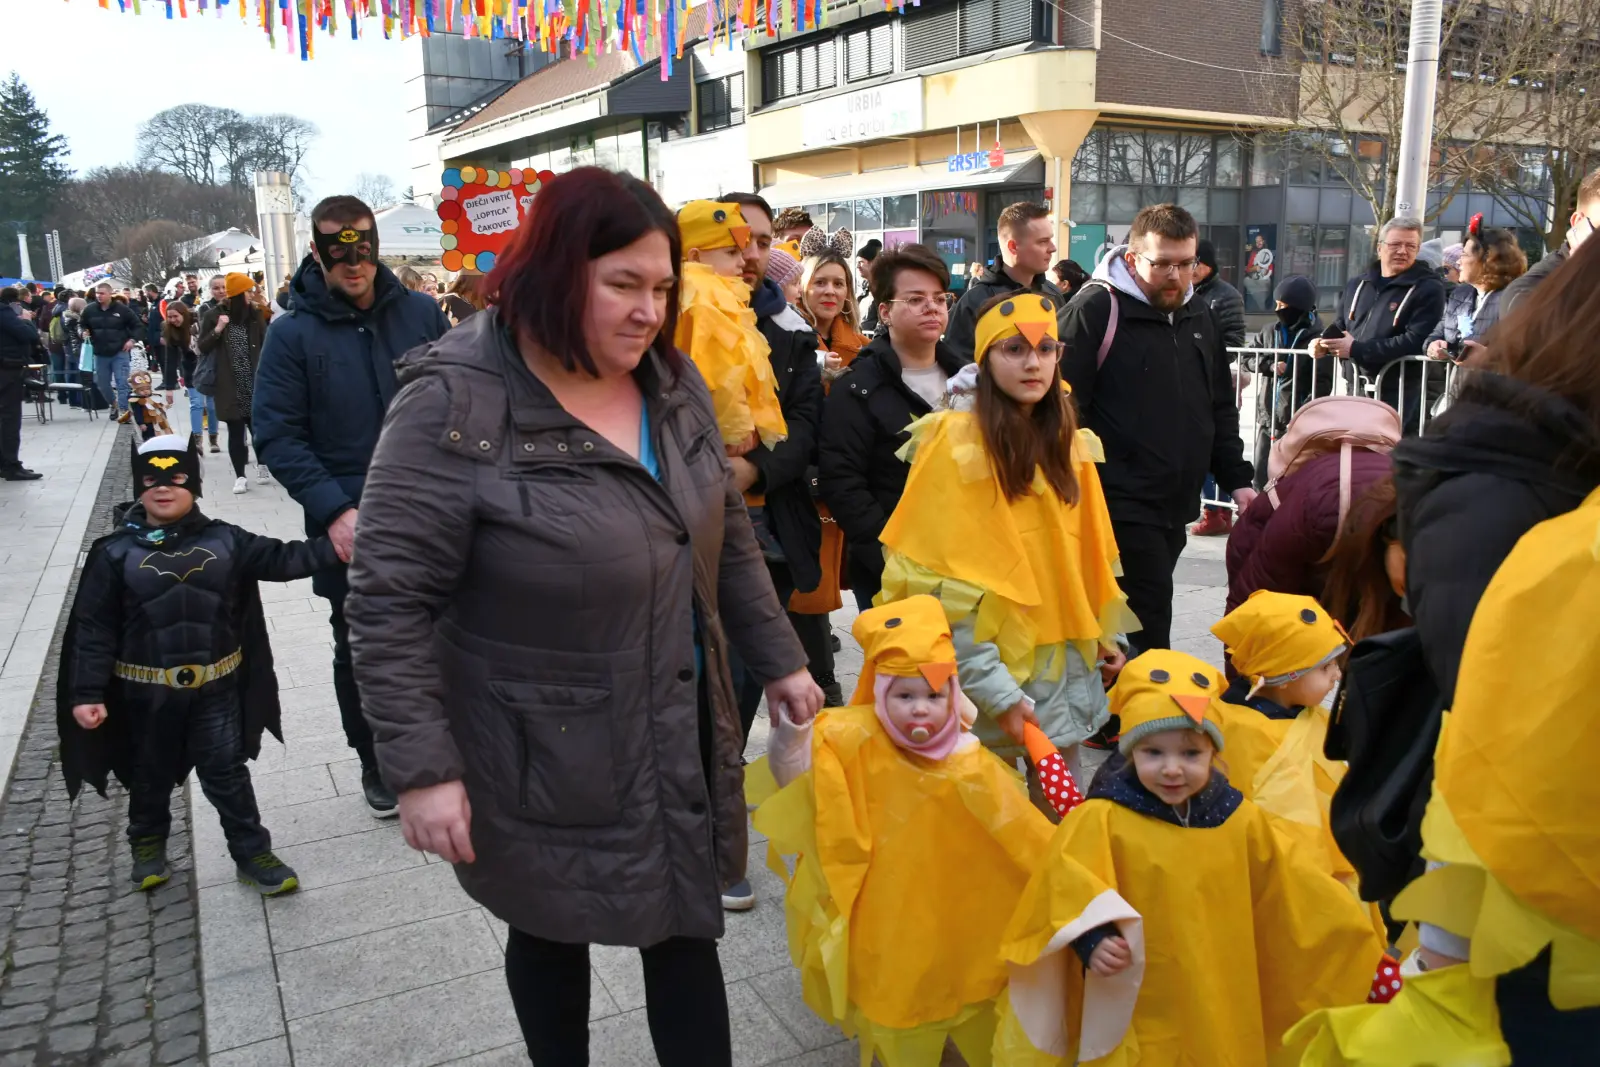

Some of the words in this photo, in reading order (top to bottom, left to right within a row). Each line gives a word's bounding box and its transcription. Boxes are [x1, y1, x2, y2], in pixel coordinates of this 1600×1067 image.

[847, 91, 882, 113] URBIA
[841, 120, 853, 138] et
[890, 110, 910, 129] 25
[948, 150, 988, 172] ERSTE
[466, 197, 489, 209] DJEČJI
[490, 191, 512, 203] VRTIĆ
[521, 197, 533, 205] JAS
[402, 226, 442, 234] PA
[477, 219, 512, 233] ČAKOVEC
